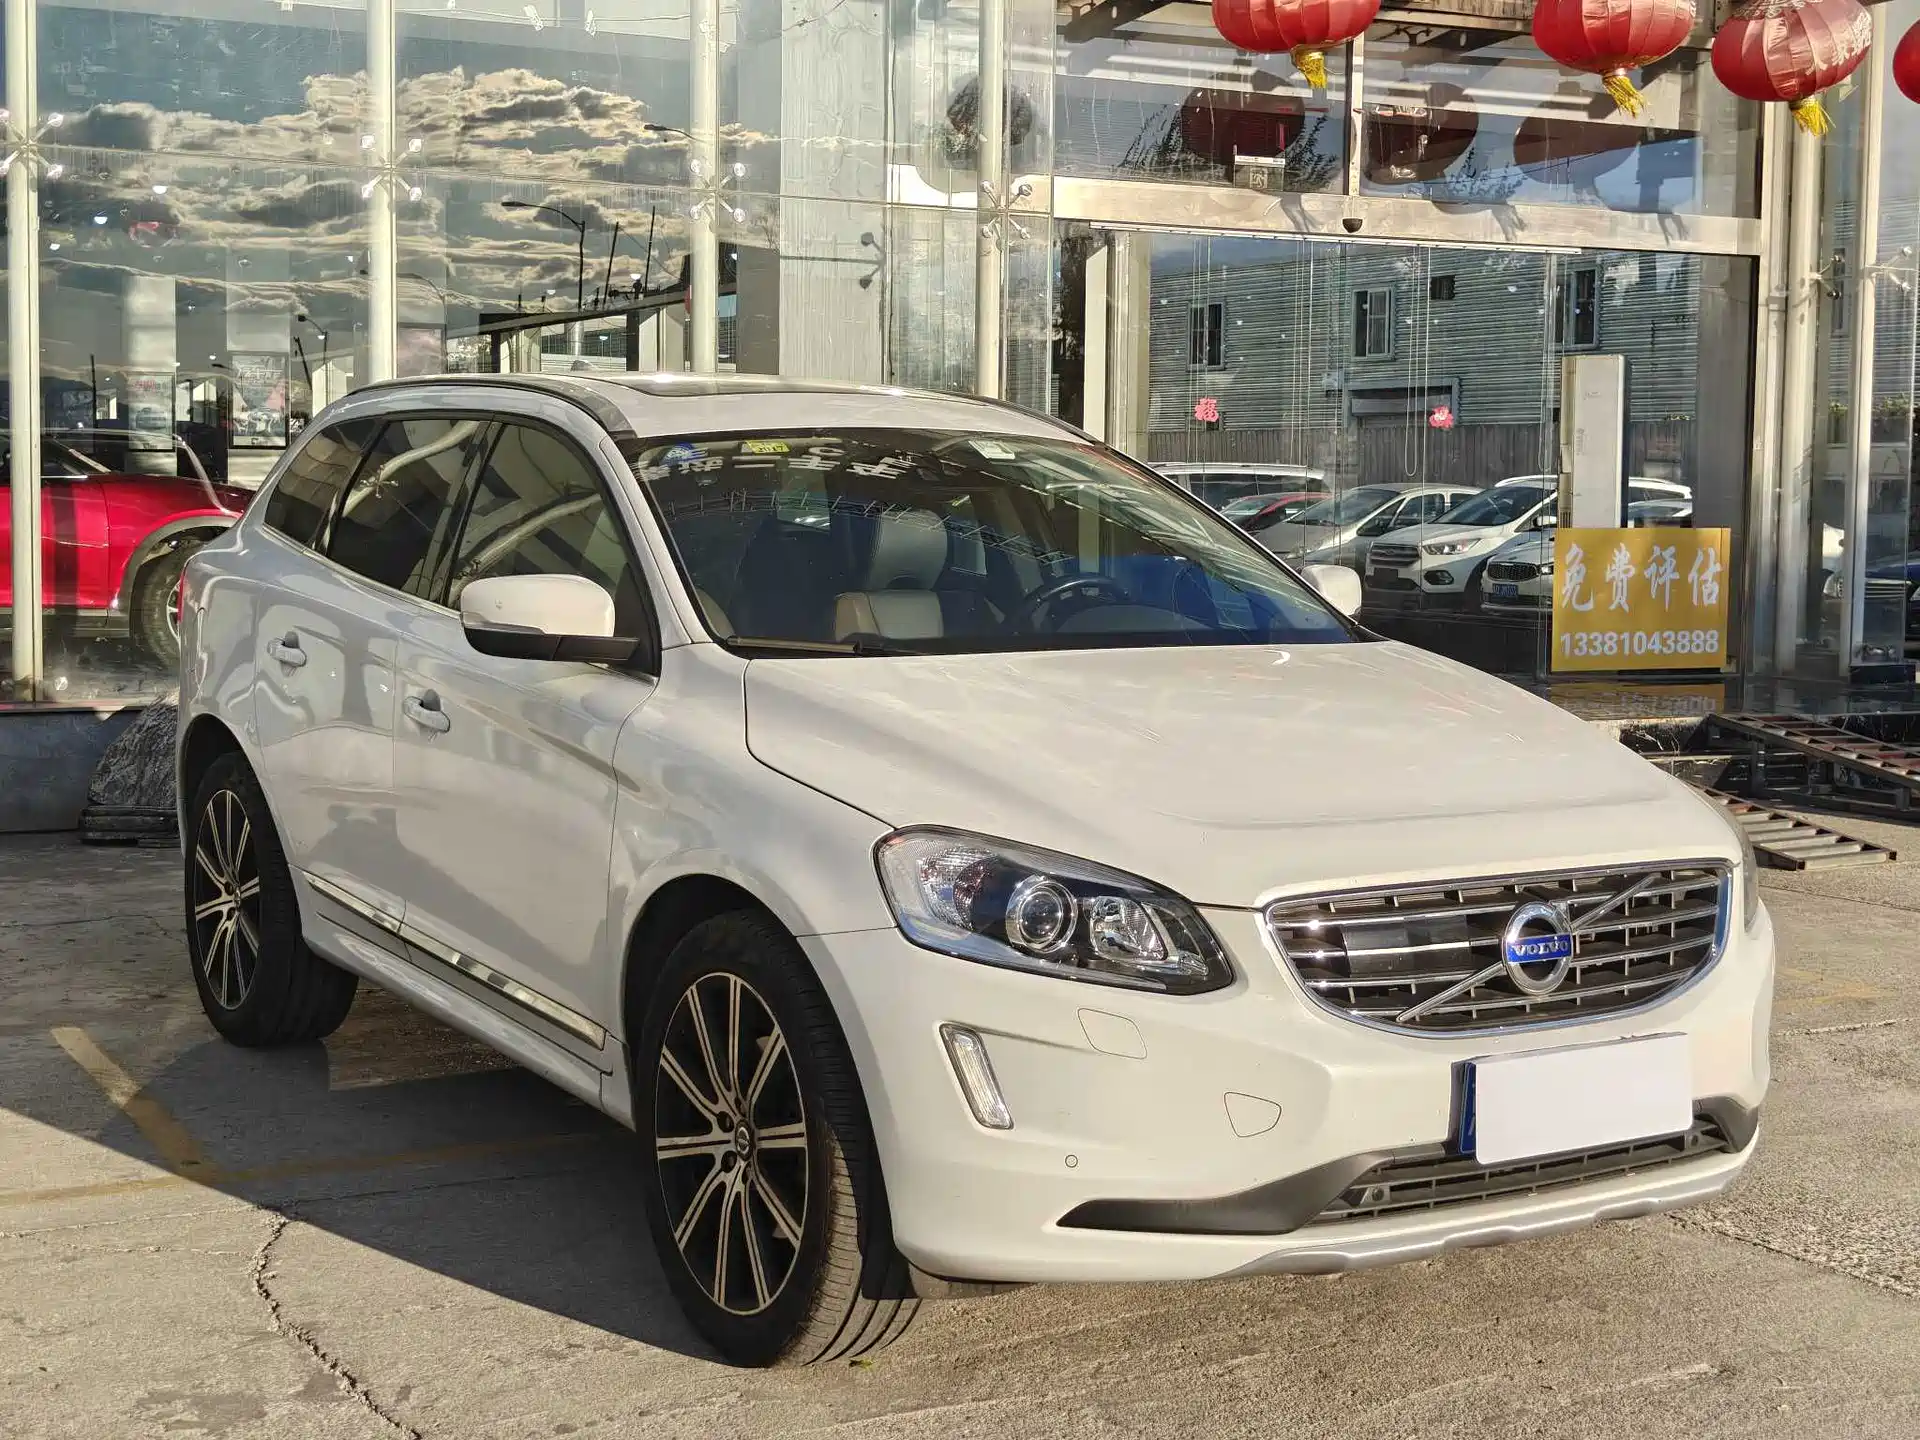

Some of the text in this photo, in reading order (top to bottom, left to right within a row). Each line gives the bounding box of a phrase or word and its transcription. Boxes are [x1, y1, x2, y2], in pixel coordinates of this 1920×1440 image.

[1562, 542, 1721, 613] 免费评估
[1560, 629, 1719, 658] 13381043888
[1511, 940, 1568, 956] VOLVO
